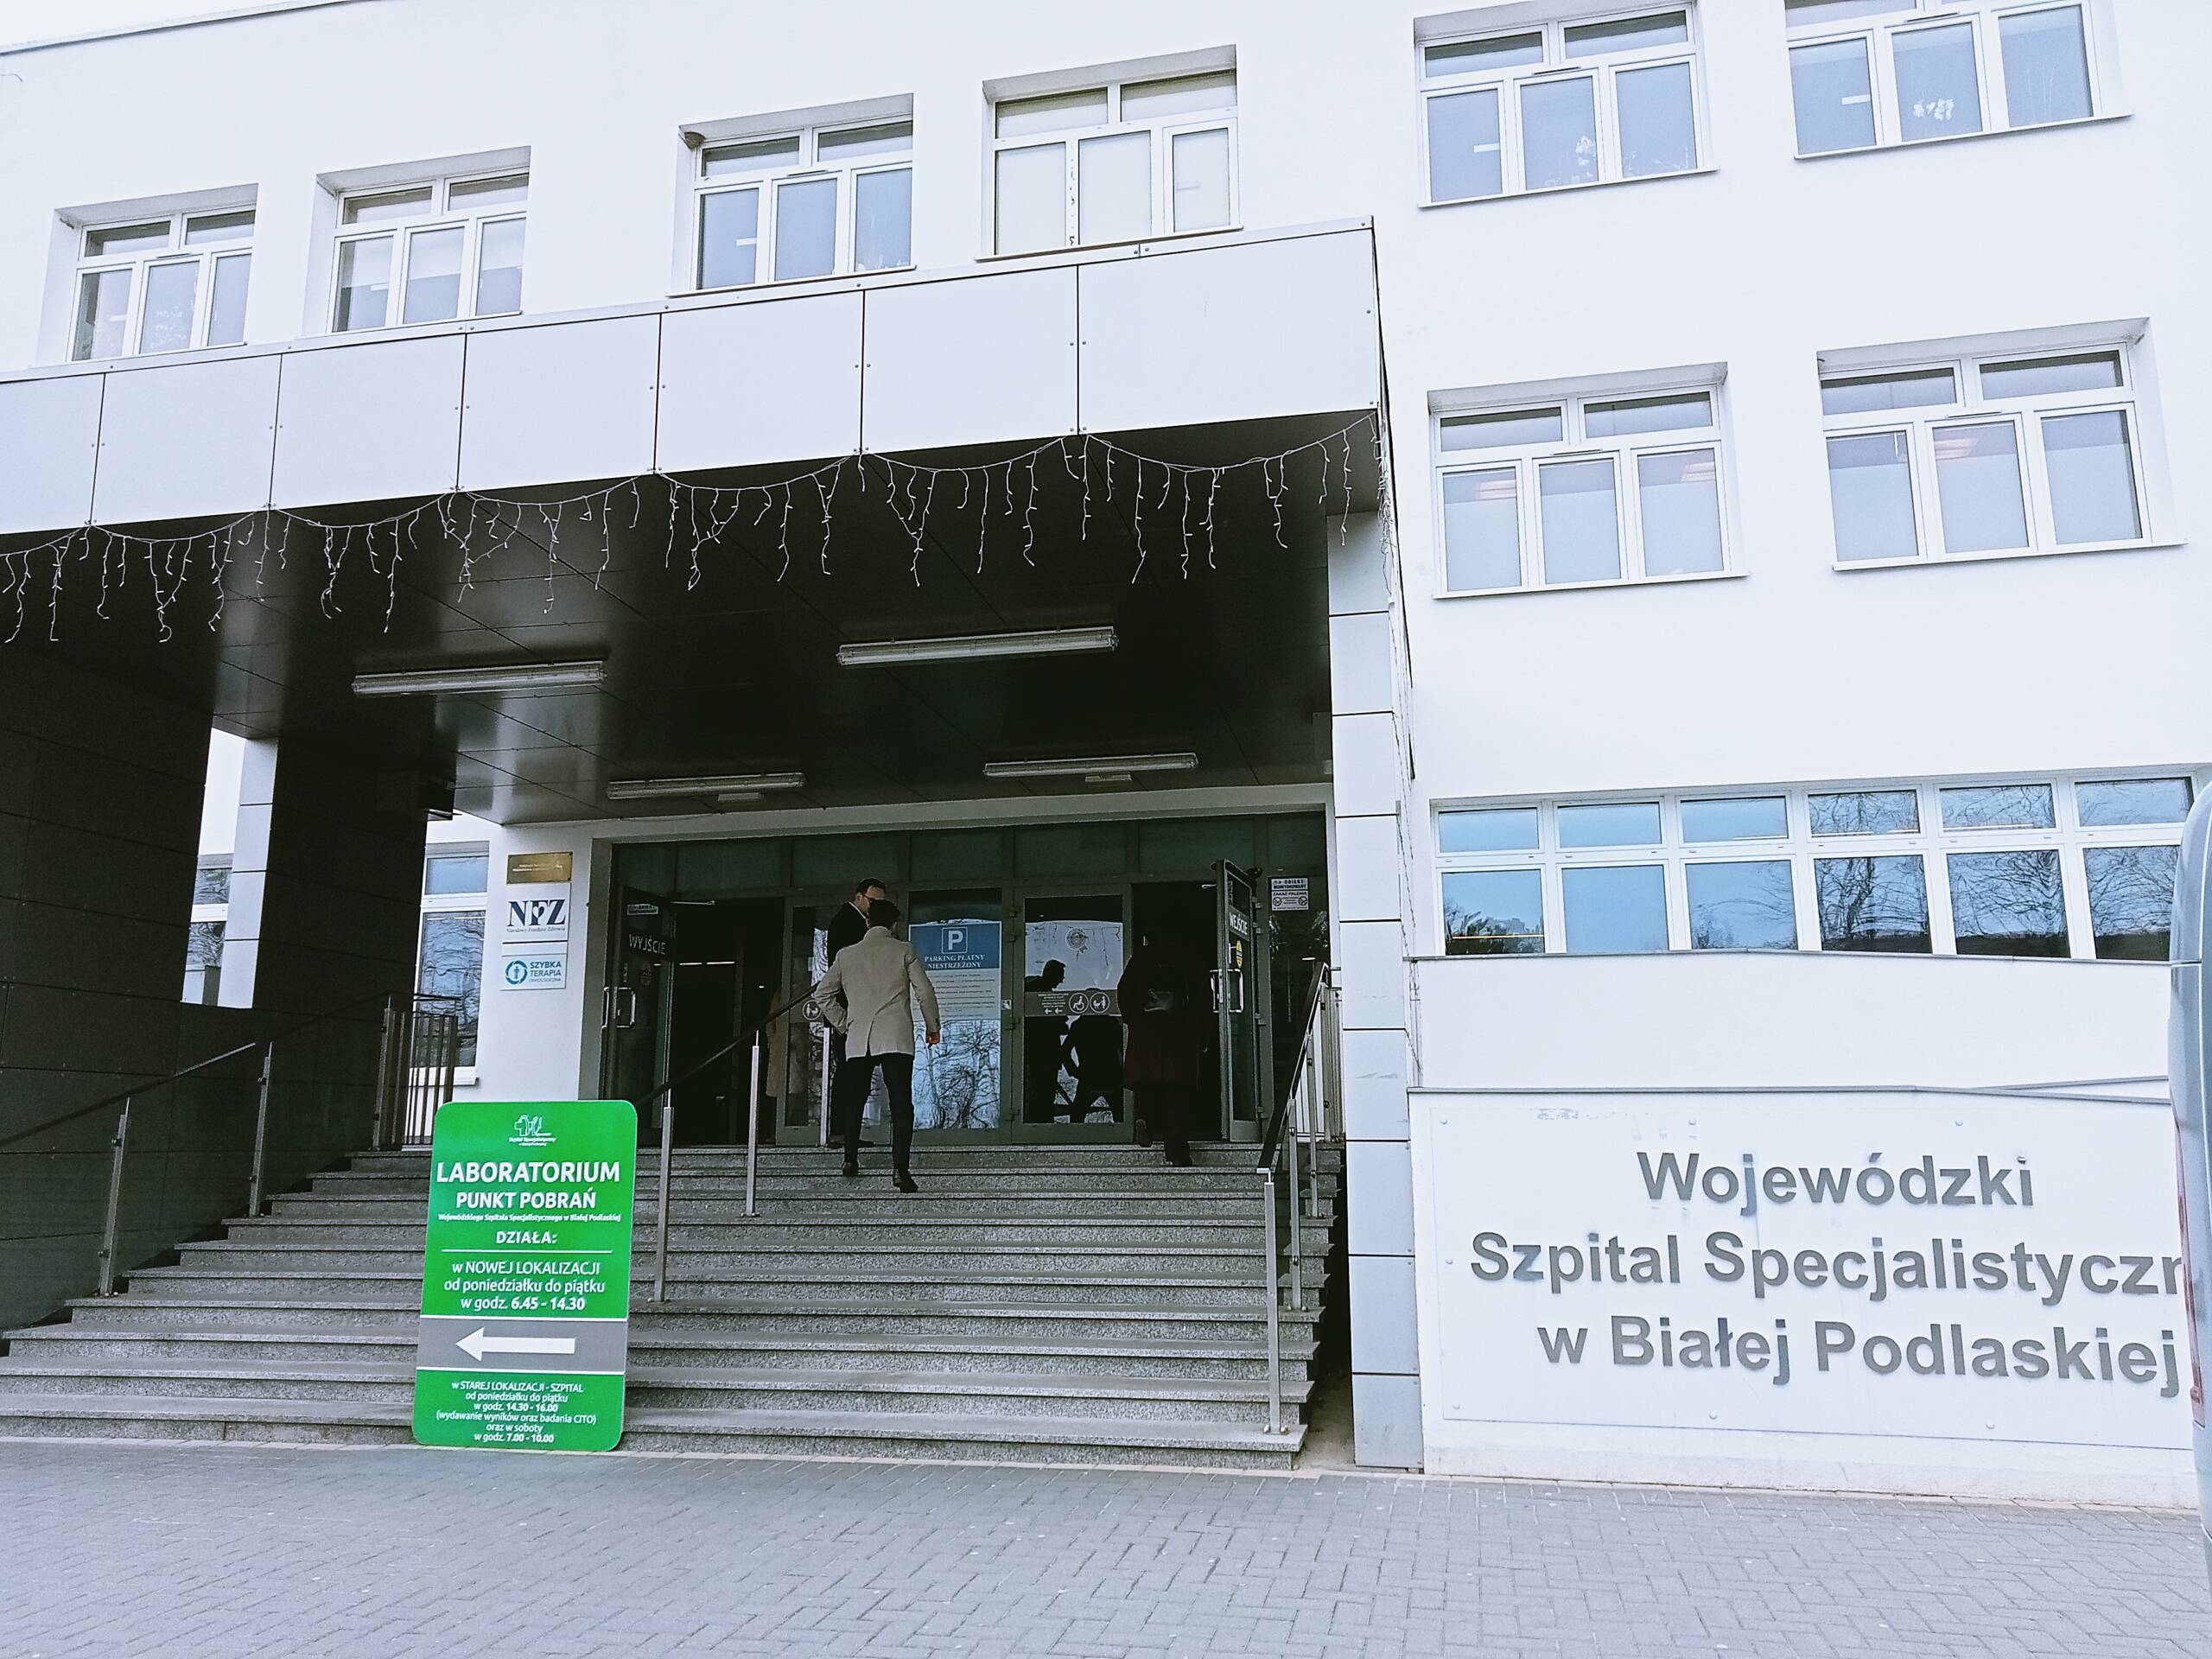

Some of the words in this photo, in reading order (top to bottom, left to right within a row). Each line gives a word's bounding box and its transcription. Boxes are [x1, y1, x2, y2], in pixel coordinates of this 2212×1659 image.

[507, 899, 566, 927] NFZ
[1229, 912, 1248, 935] WEJŚCIE
[629, 933, 666, 955] WYJŚCIE
[948, 931, 963, 950] P
[436, 1162, 620, 1183] LABORATORIUM
[1637, 1151, 2035, 1217] Wojewódzki
[456, 1192, 517, 1209] PUNKT
[519, 1187, 596, 1209] POBRAŃ
[496, 1231, 558, 1244] DZIAŁA:
[453, 1264, 465, 1273] w
[466, 1262, 514, 1274] NOWEJ
[516, 1262, 601, 1274] LOKALIZACJI
[1471, 1231, 1682, 1294] Szpital
[444, 1279, 461, 1291] od
[462, 1279, 543, 1294] poniedziałku
[545, 1280, 561, 1292] do
[564, 1281, 605, 1295] piątku
[461, 1299, 474, 1309] w
[474, 1297, 508, 1312] godz.
[511, 1297, 538, 1310] 6.45
[550, 1298, 586, 1311] 14.30
[1537, 1325, 1588, 1363] w
[1611, 1316, 1790, 1384] Białej
[1814, 1321, 2179, 1397] Podlaskiej
[460, 1382, 492, 1391] STAREJ
[492, 1382, 544, 1392] LOKALIZACJI
[550, 1384, 583, 1393] SZPITAL
[466, 1392, 476, 1401] od
[478, 1392, 529, 1402] poniedziałku
[530, 1393, 540, 1402] do
[542, 1394, 568, 1403] piątku
[482, 1402, 504, 1412] godz.
[506, 1402, 529, 1412] 14.30
[536, 1403, 558, 1412] 16.00
[436, 1411, 482, 1422] (wydawanie
[484, 1413, 519, 1423] wyników
[540, 1414, 572, 1423] badania
[574, 1414, 596, 1426] CITO)
[514, 1423, 543, 1434] soboty
[482, 1433, 505, 1443] godz.
[506, 1433, 524, 1442] 7.00
[531, 1434, 554, 1443] 10.00
